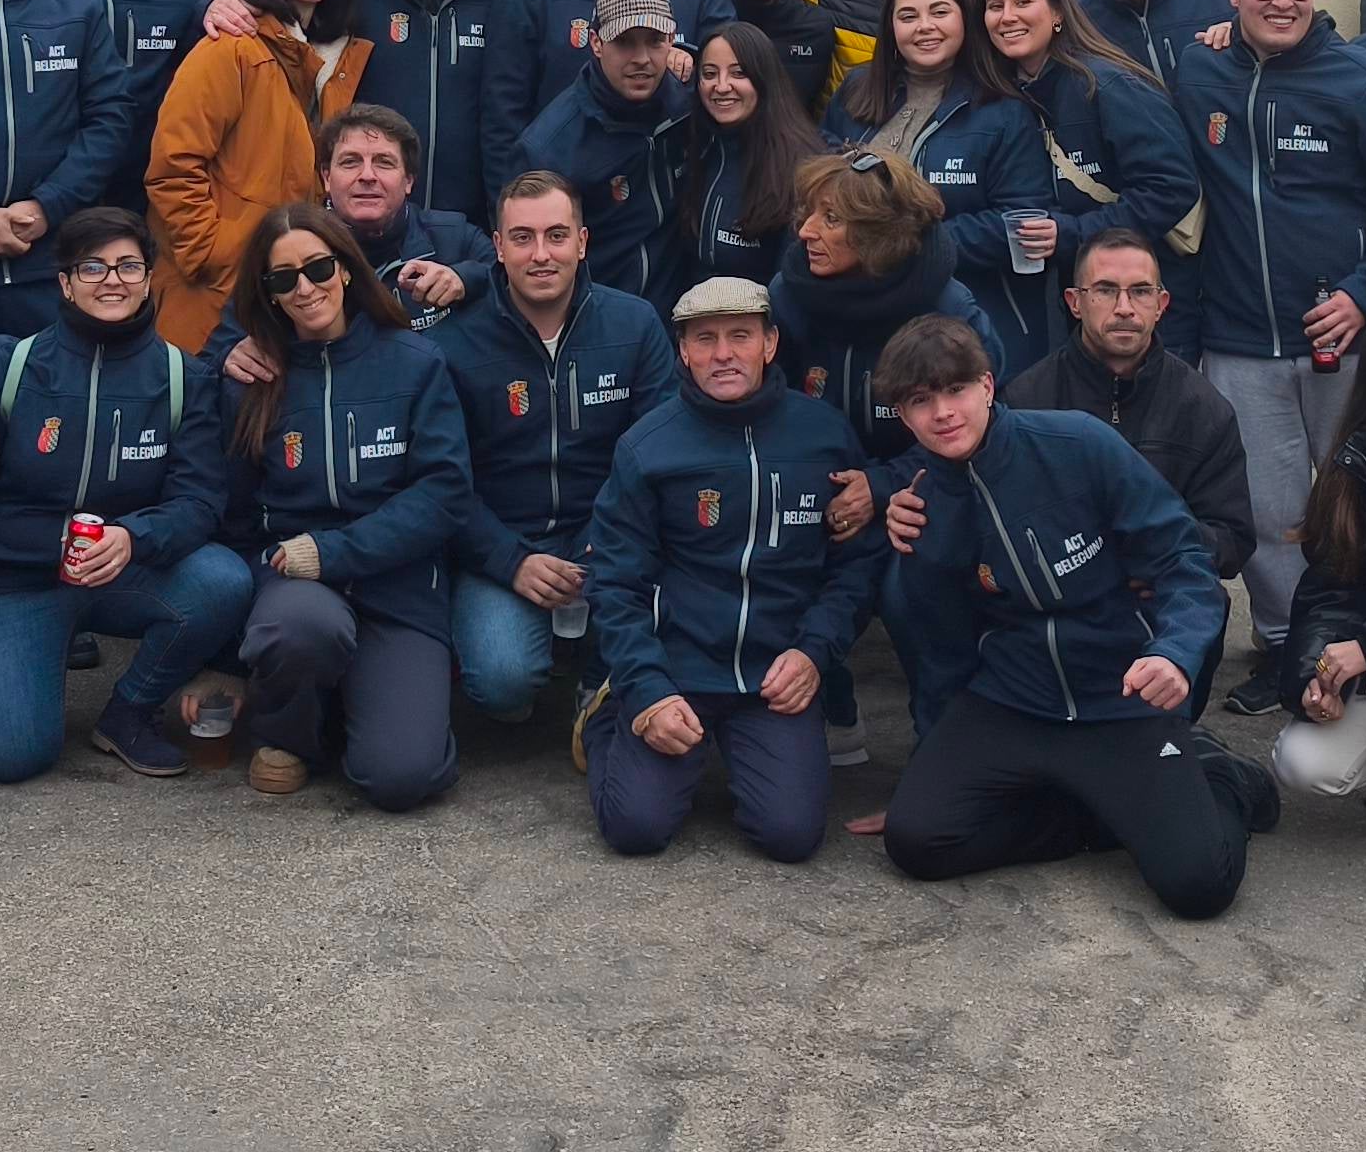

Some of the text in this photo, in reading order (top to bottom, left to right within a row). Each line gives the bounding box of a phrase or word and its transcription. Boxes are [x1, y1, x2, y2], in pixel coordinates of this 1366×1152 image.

[151, 26, 166, 37] ACT
[470, 24, 483, 36] ACT
[49, 45, 66, 58] ACT
[790, 45, 813, 56] FILA
[34, 58, 78, 73] BELEGUINA
[1293, 124, 1313, 138] ACT
[1277, 138, 1329, 153] BELEGUINA
[945, 158, 964, 171] ACT
[929, 172, 978, 185] BELEGUINA
[598, 373, 617, 388] ACT
[583, 388, 630, 406] BELEGUINA
[139, 429, 155, 443] ACT
[376, 426, 396, 442] ACT
[799, 493, 816, 508] ACT
[1064, 532, 1086, 554] ACT
[1054, 536, 1104, 577] BELEGUINA
